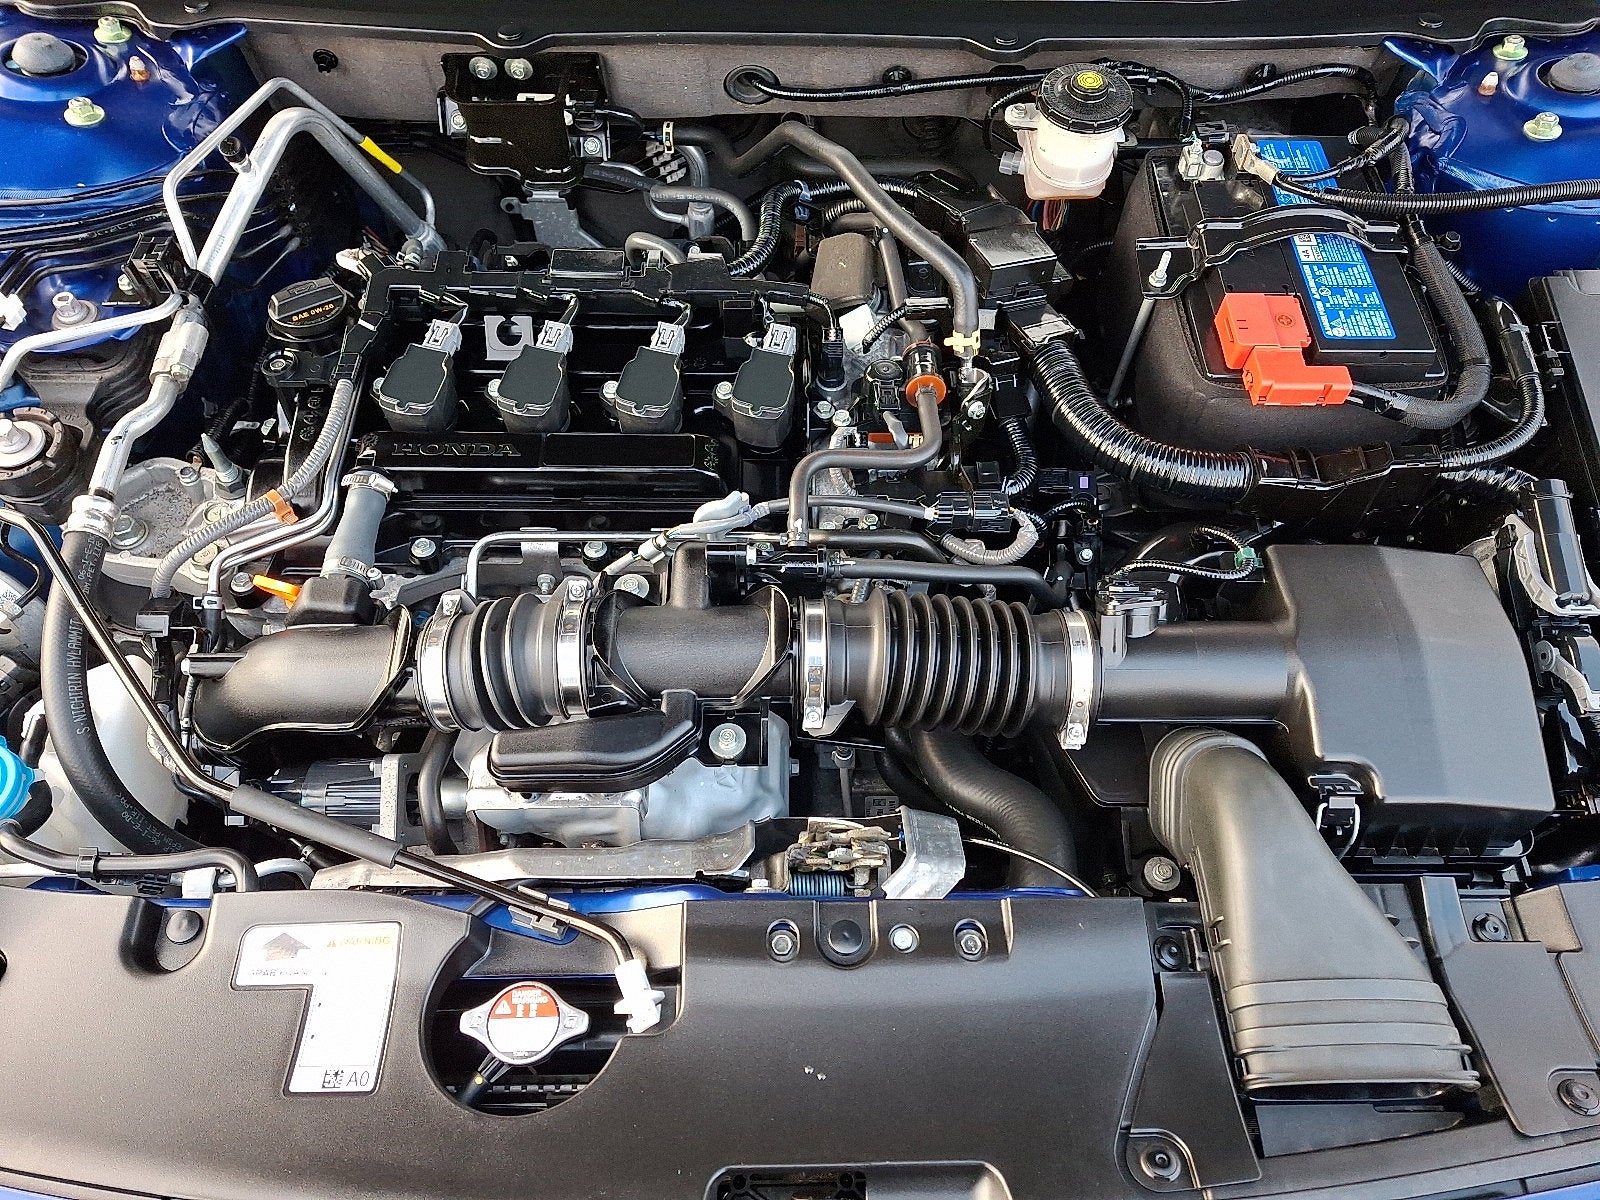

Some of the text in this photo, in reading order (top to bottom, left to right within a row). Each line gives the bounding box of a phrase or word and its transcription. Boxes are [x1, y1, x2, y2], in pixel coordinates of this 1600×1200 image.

[310, 303, 335, 315] 0W-20
[392, 443, 521, 457] HONDA
[67, 616, 83, 669] HYLAMMIT
[340, 935, 391, 946] WARNING
